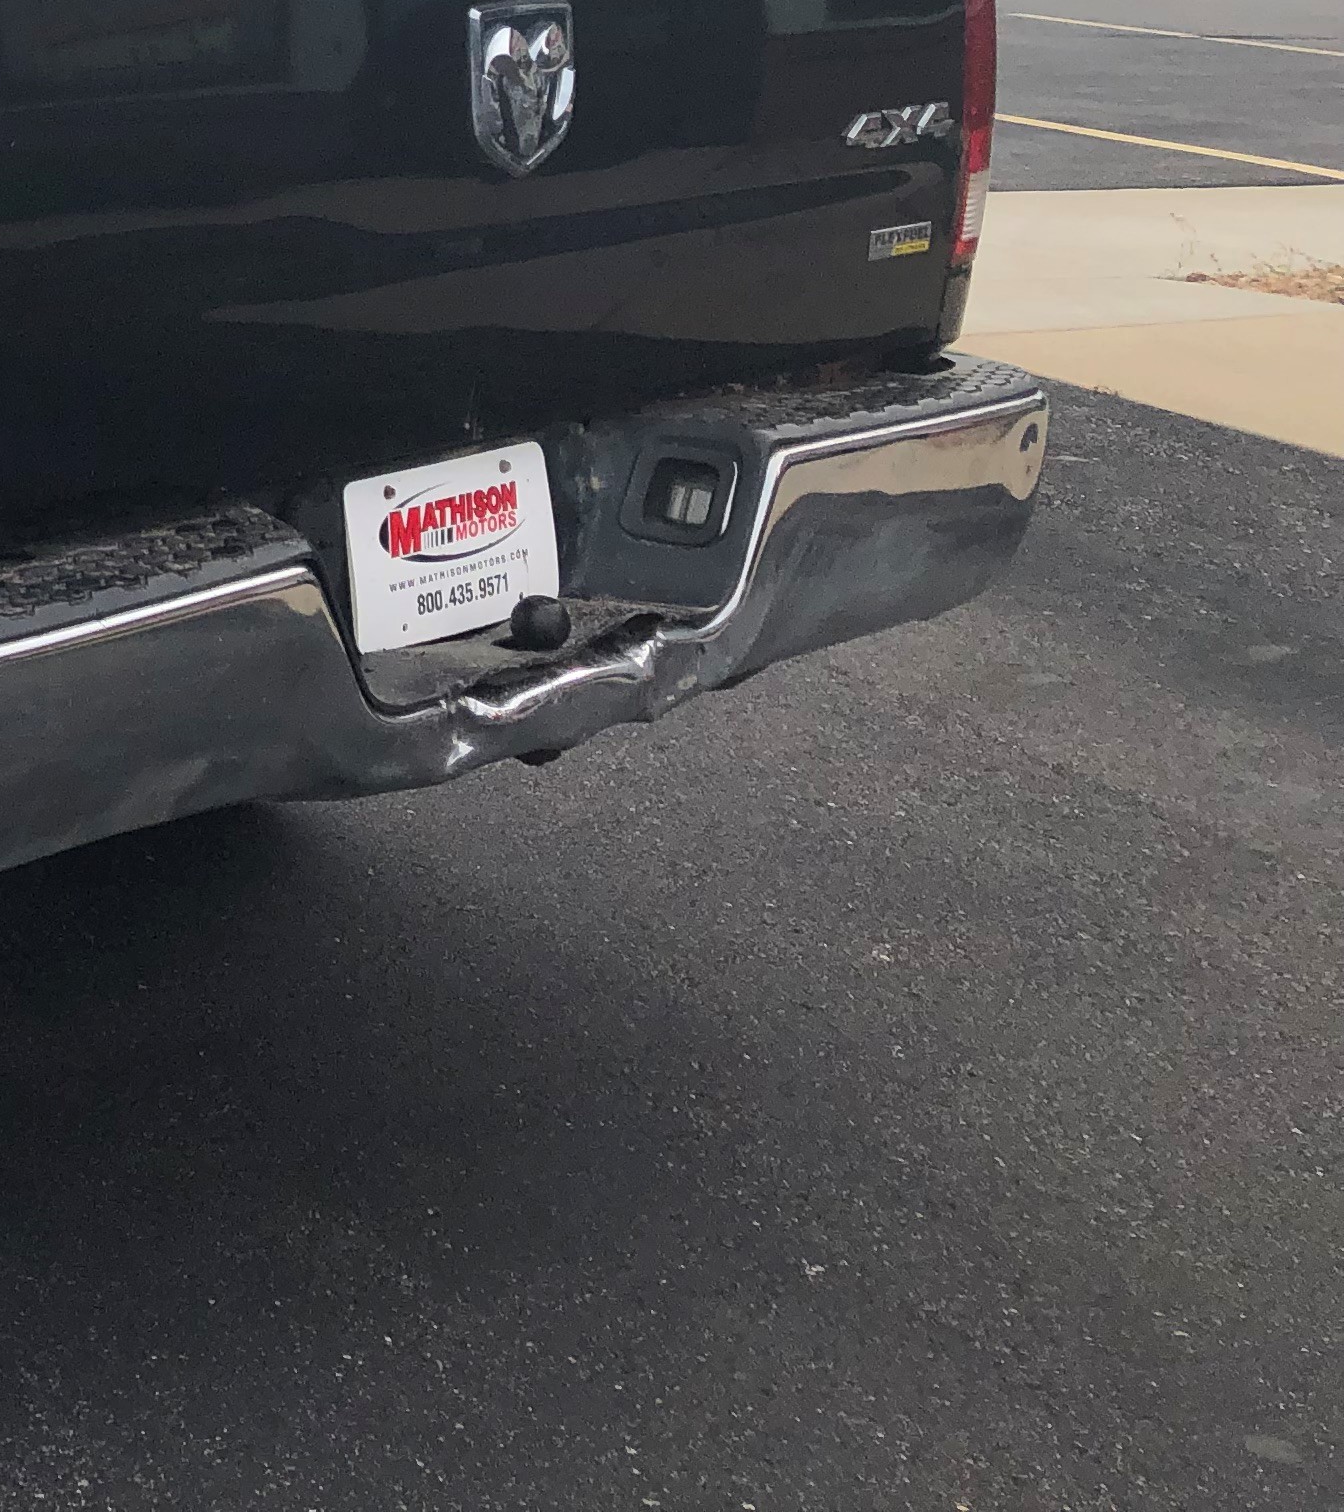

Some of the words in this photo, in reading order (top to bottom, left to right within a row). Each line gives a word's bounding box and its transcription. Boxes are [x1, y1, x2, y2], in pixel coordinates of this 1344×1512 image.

[388, 480, 519, 559] MATHISON
[455, 511, 518, 542] MOTORS
[417, 571, 509, 616] 800.435.9571
